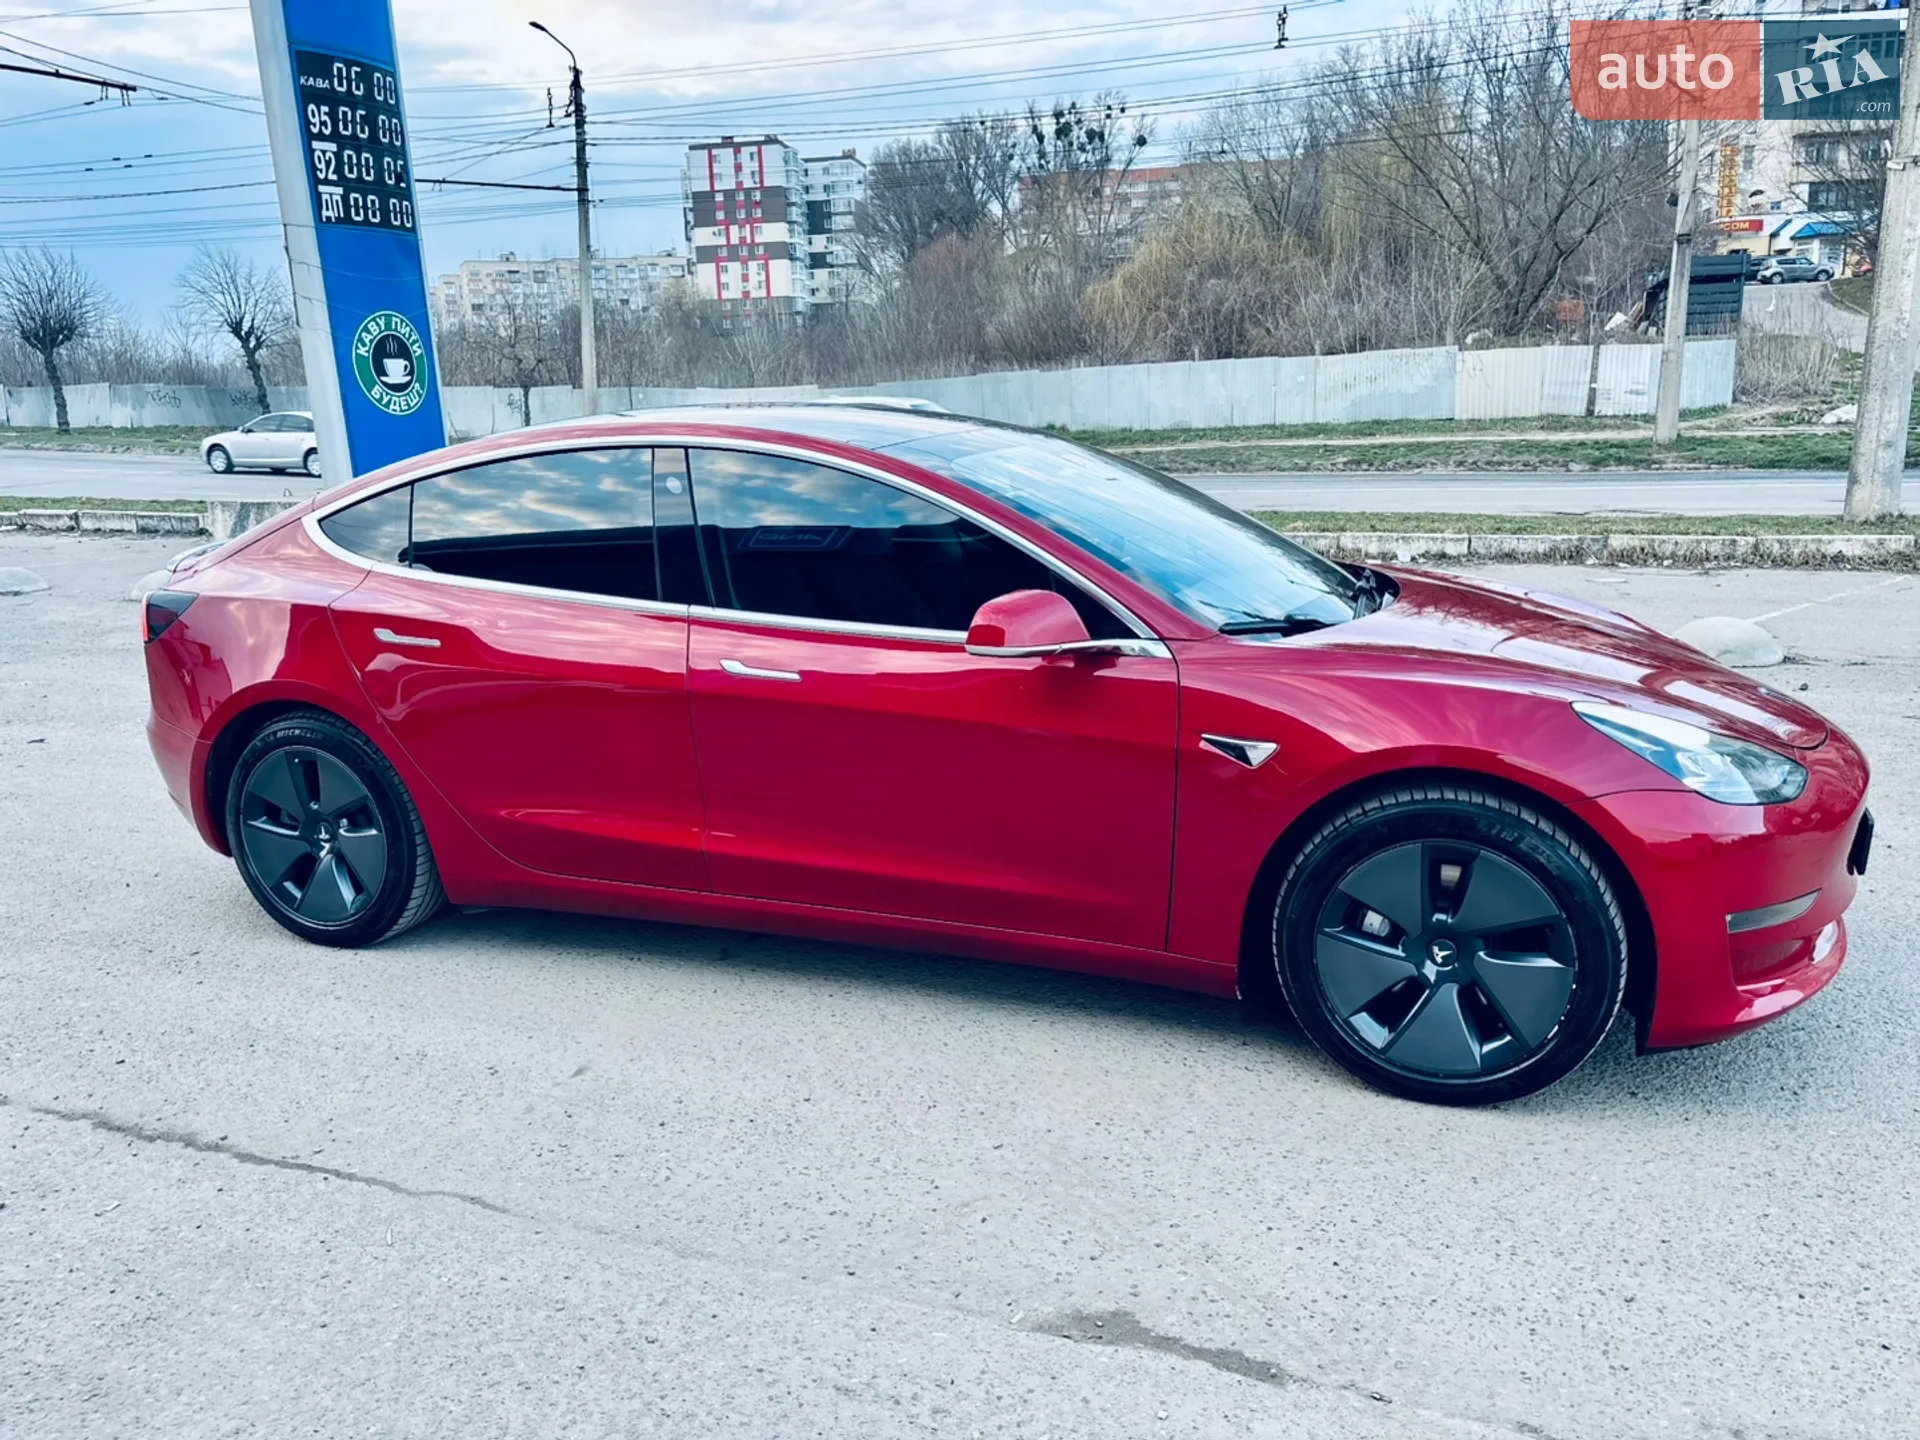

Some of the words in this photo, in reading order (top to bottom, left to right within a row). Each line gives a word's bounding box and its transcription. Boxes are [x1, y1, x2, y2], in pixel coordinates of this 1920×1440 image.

[300, 75, 331, 90] КАВА
[307, 103, 332, 136] 95
[314, 149, 338, 181] 92
[321, 193, 344, 223] ДП
[356, 316, 385, 358] КАВУ
[391, 316, 423, 357] ПИТИ
[370, 382, 424, 413] БУДЕШ?
